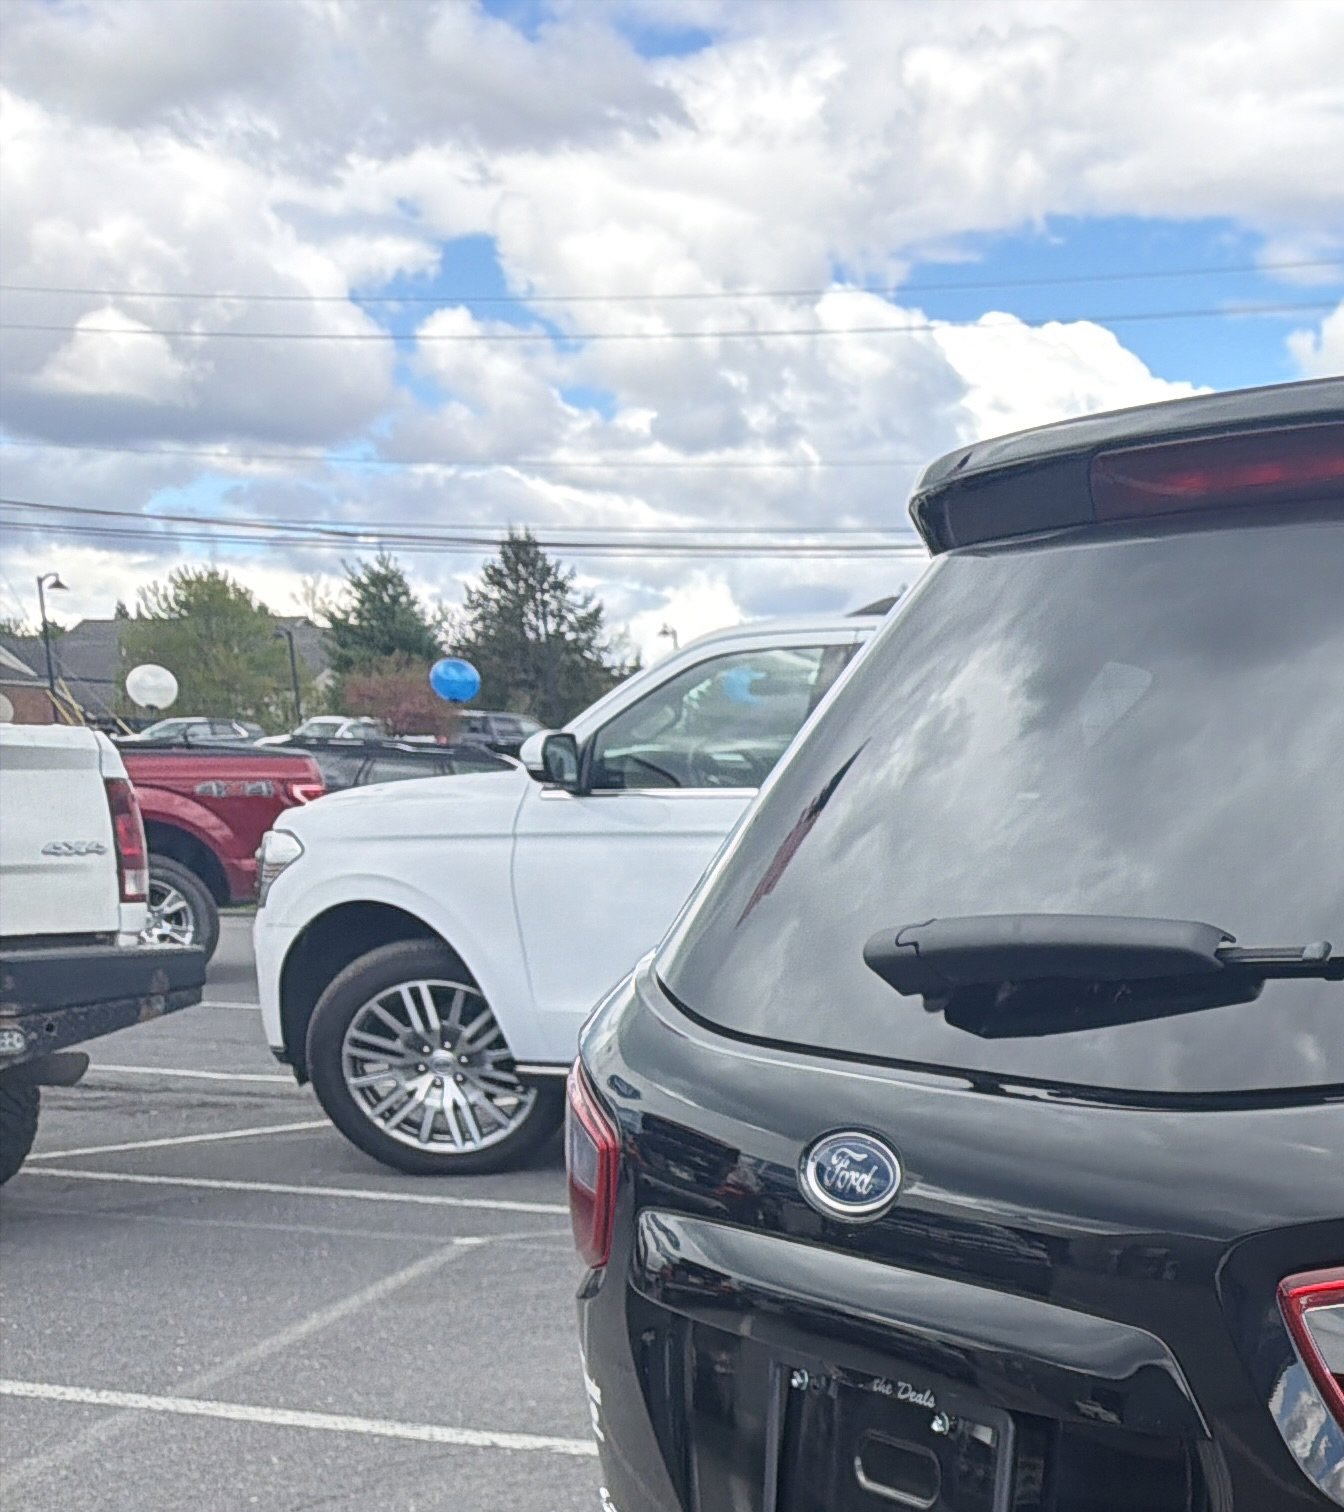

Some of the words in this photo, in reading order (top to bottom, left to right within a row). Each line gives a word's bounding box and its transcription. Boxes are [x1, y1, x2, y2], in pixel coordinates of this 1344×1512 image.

[823, 1147, 879, 1196] Ford
[871, 1375, 893, 1396] the
[896, 1380, 937, 1409] Deals
